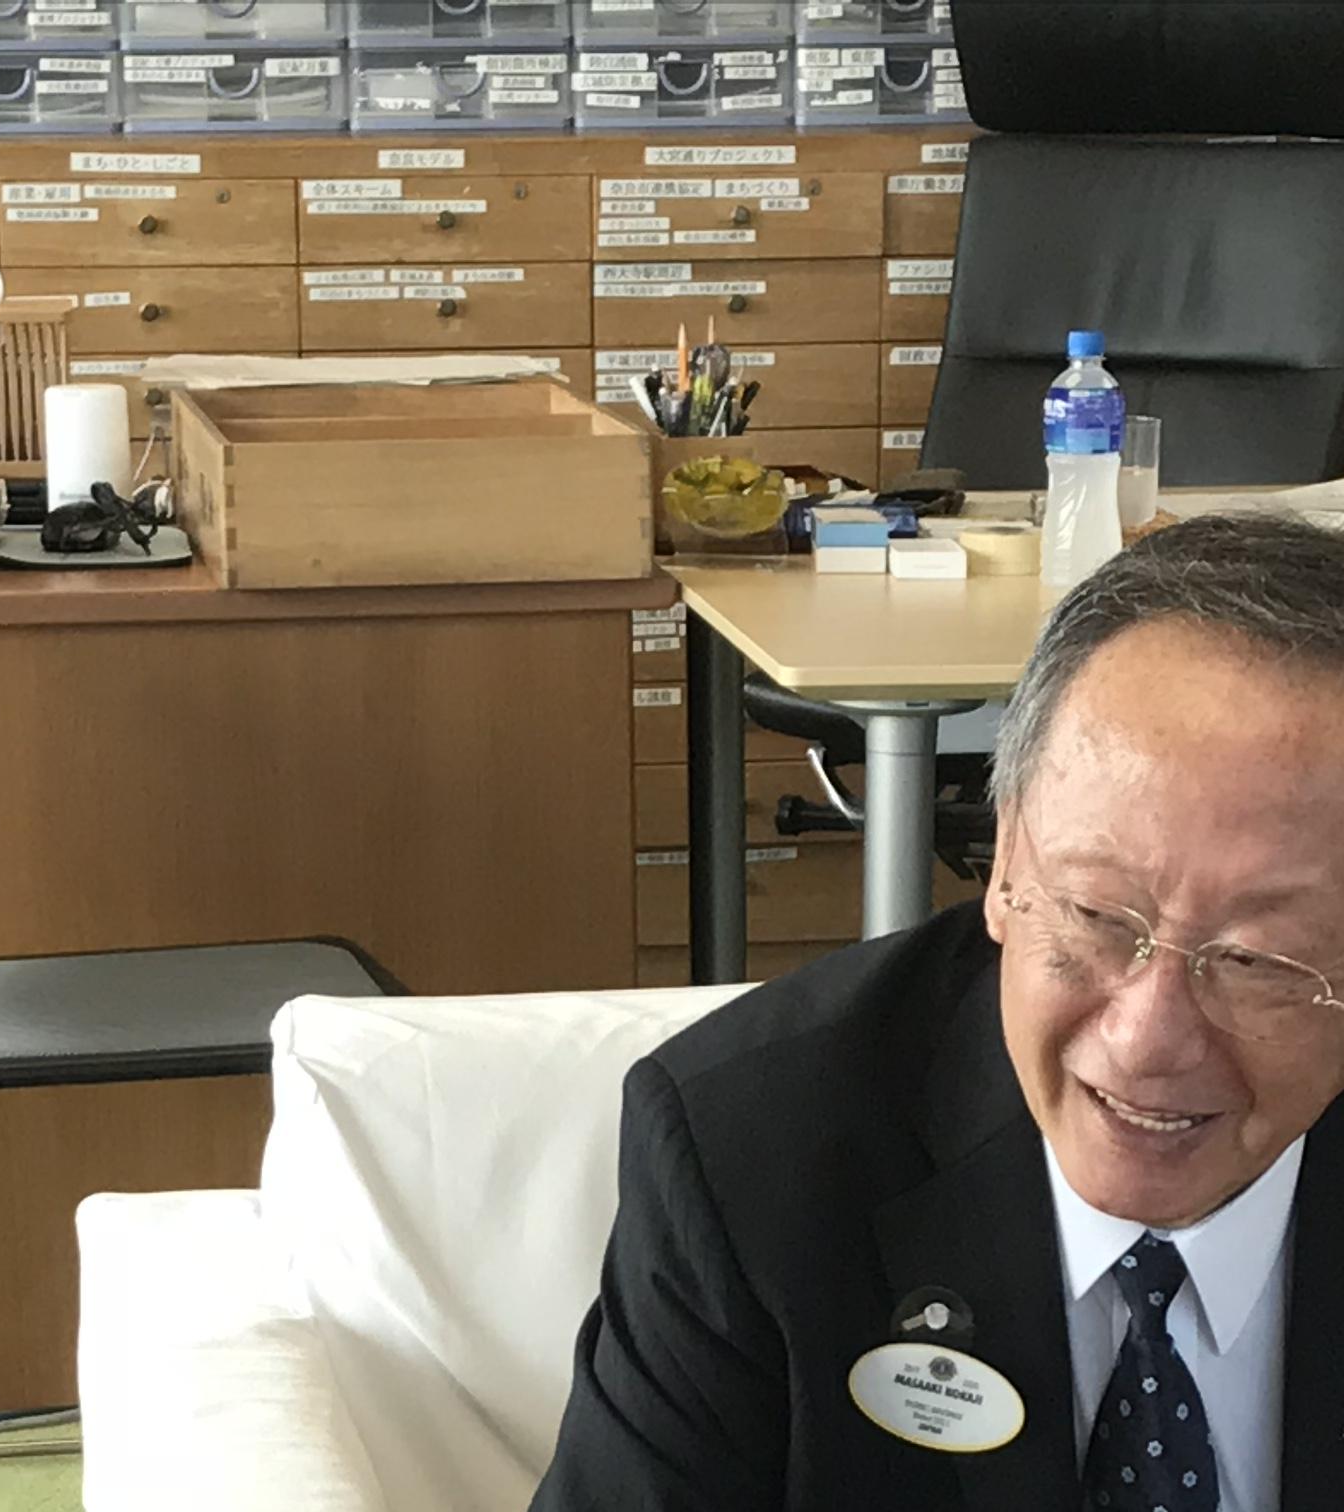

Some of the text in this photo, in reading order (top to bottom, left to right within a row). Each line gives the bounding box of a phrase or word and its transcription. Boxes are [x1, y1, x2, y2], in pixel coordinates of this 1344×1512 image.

[390, 153, 454, 165] 奈良モデル
[655, 149, 785, 162] 大宮通りプロジェクト
[83, 157, 190, 169] まち・ひと・しごと
[313, 184, 392, 195] 全体スキーム
[725, 182, 789, 195] まちづくり
